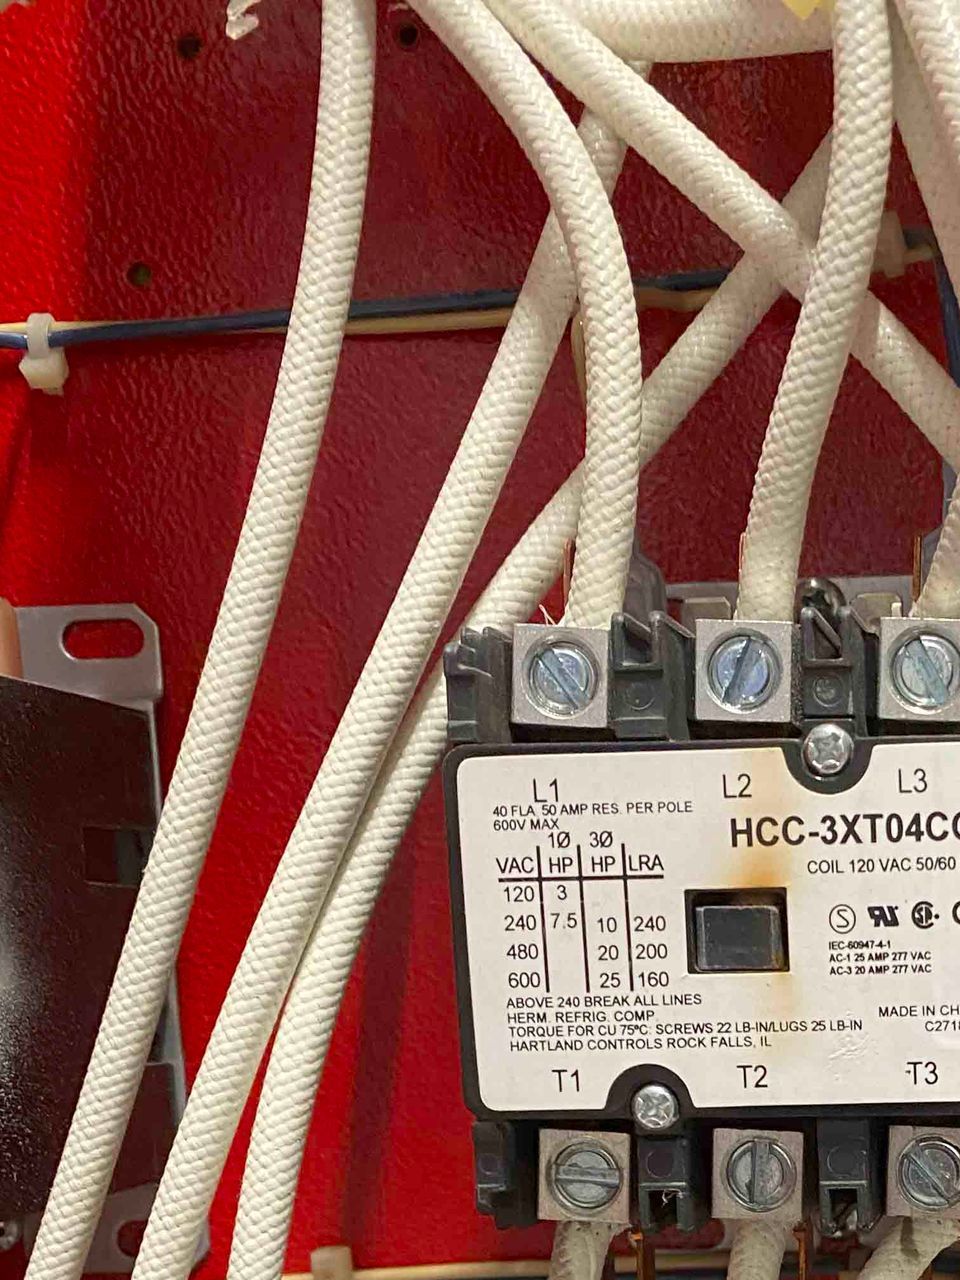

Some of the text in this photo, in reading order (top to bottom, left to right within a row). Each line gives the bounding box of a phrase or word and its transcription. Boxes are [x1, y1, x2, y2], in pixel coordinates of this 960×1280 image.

[722, 774, 752, 798] L2
[898, 768, 928, 793] L3
[533, 778, 559, 803] L1
[493, 806, 507, 817] 40
[542, 804, 557, 816] 50
[560, 804, 588, 816] AMP
[627, 803, 655, 814] PER
[658, 802, 693, 813] POLE
[493, 819, 560, 831] 600V MAX
[496, 855, 664, 874] VAC HP HP LRA
[807, 859, 844, 874] COIL
[850, 859, 874, 873] 120
[879, 858, 912, 872] VAC
[916, 857, 956, 872] 50/60
[503, 885, 567, 902] 120 3
[504, 913, 666, 933] 240 7.5 10 240
[506, 944, 668, 961] 480 20 200
[829, 951, 932, 963] AC-1 25 AMP 277 VAC
[508, 971, 669, 989] 600 25 160
[506, 994, 702, 1009] ABOVE 240 BREAK ALL LINES
[879, 1005, 918, 1017] MADE
[923, 1005, 935, 1016] IN
[510, 1026, 566, 1040] TORQUE
[568, 1026, 595, 1037] FOR
[598, 1025, 618, 1037] CU
[656, 1022, 713, 1036] SCREWS
[716, 1022, 732, 1034] 22
[811, 1020, 827, 1032] 25
[830, 1020, 863, 1032] LB-IN
[510, 1040, 583, 1052] HARTLAND
[588, 1038, 663, 1050] CONTROLS
[667, 1037, 706, 1049] ROCK
[760, 1036, 772, 1048] IL
[552, 1069, 581, 1093] T1
[737, 1065, 769, 1089] T2
[907, 1061, 939, 1085] T3
